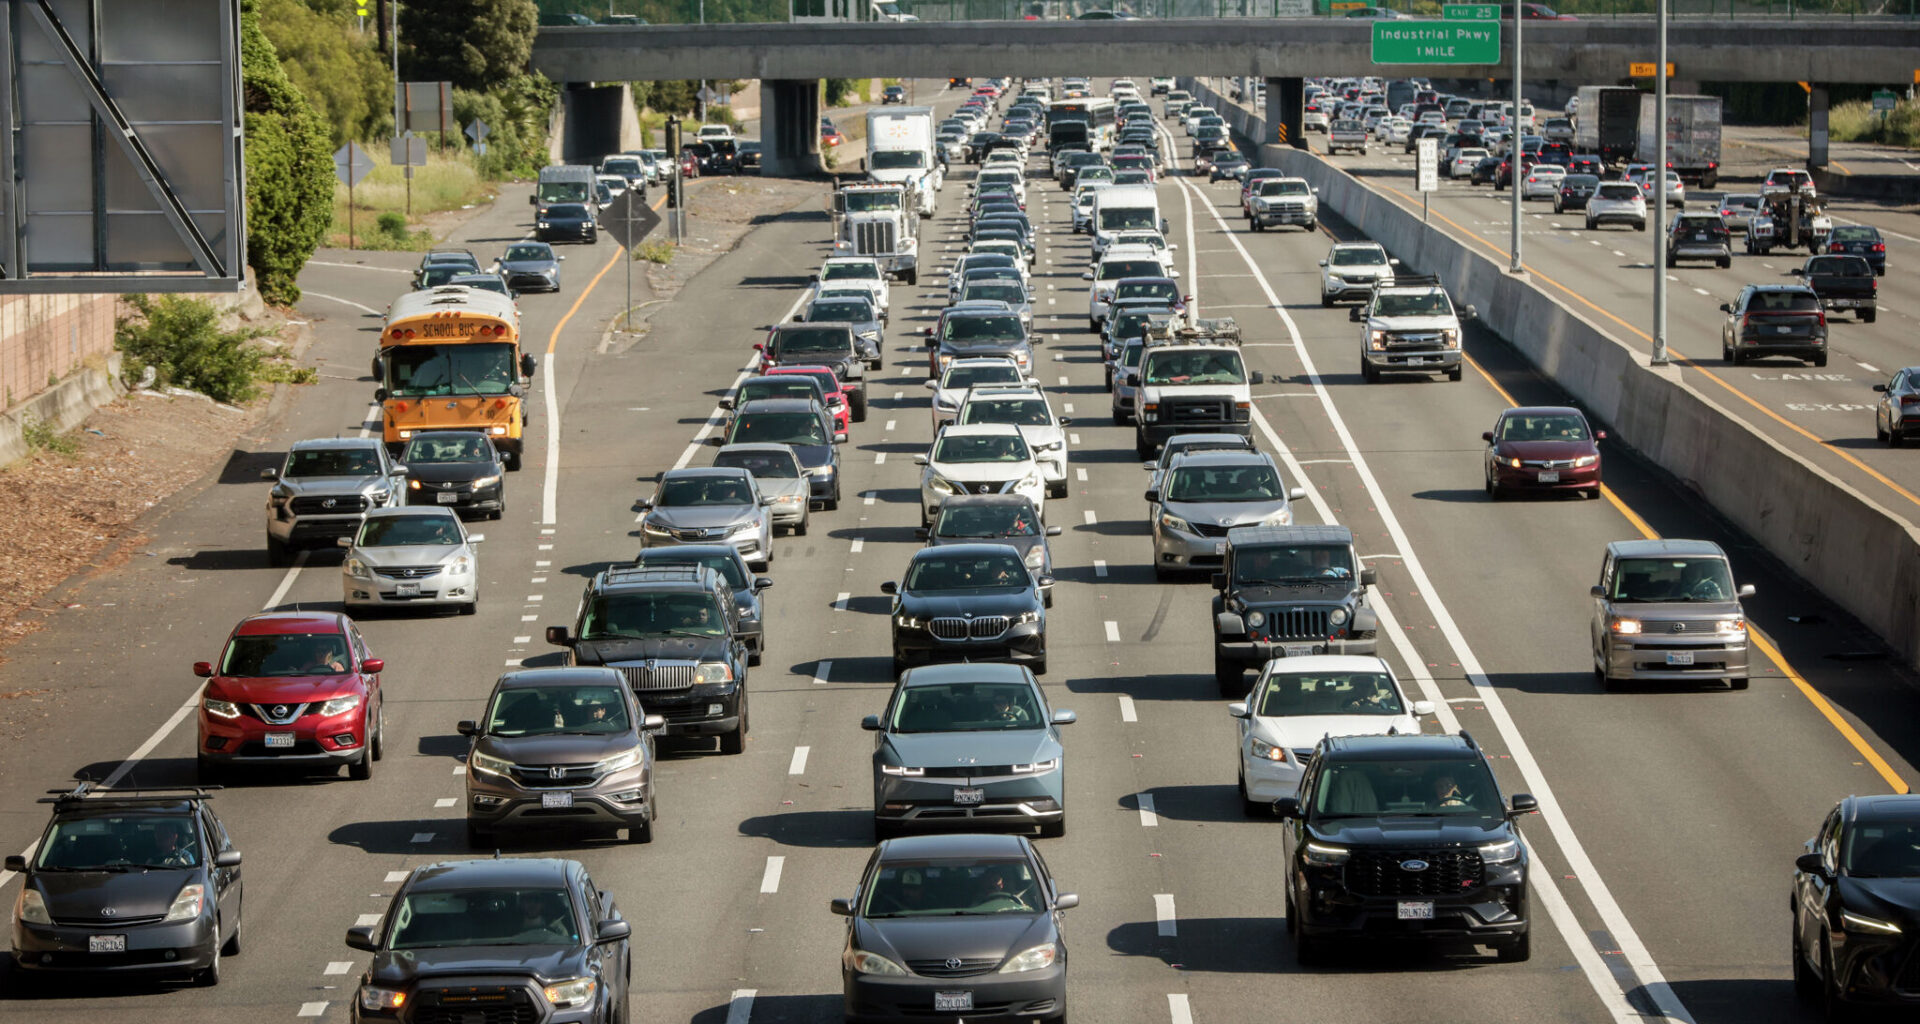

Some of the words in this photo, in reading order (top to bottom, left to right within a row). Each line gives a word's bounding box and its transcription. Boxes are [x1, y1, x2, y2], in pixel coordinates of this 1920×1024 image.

[1451, 9, 1469, 17] EXIT
[1476, 7, 1492, 18] 25
[1381, 29, 1449, 40] Industrial
[1457, 29, 1491, 42] Pkwy
[1425, 46, 1456, 57] MILE
[423, 323, 455, 337] SCHOOL
[459, 322, 475, 337] BUS
[1752, 373, 1852, 382] LANE
